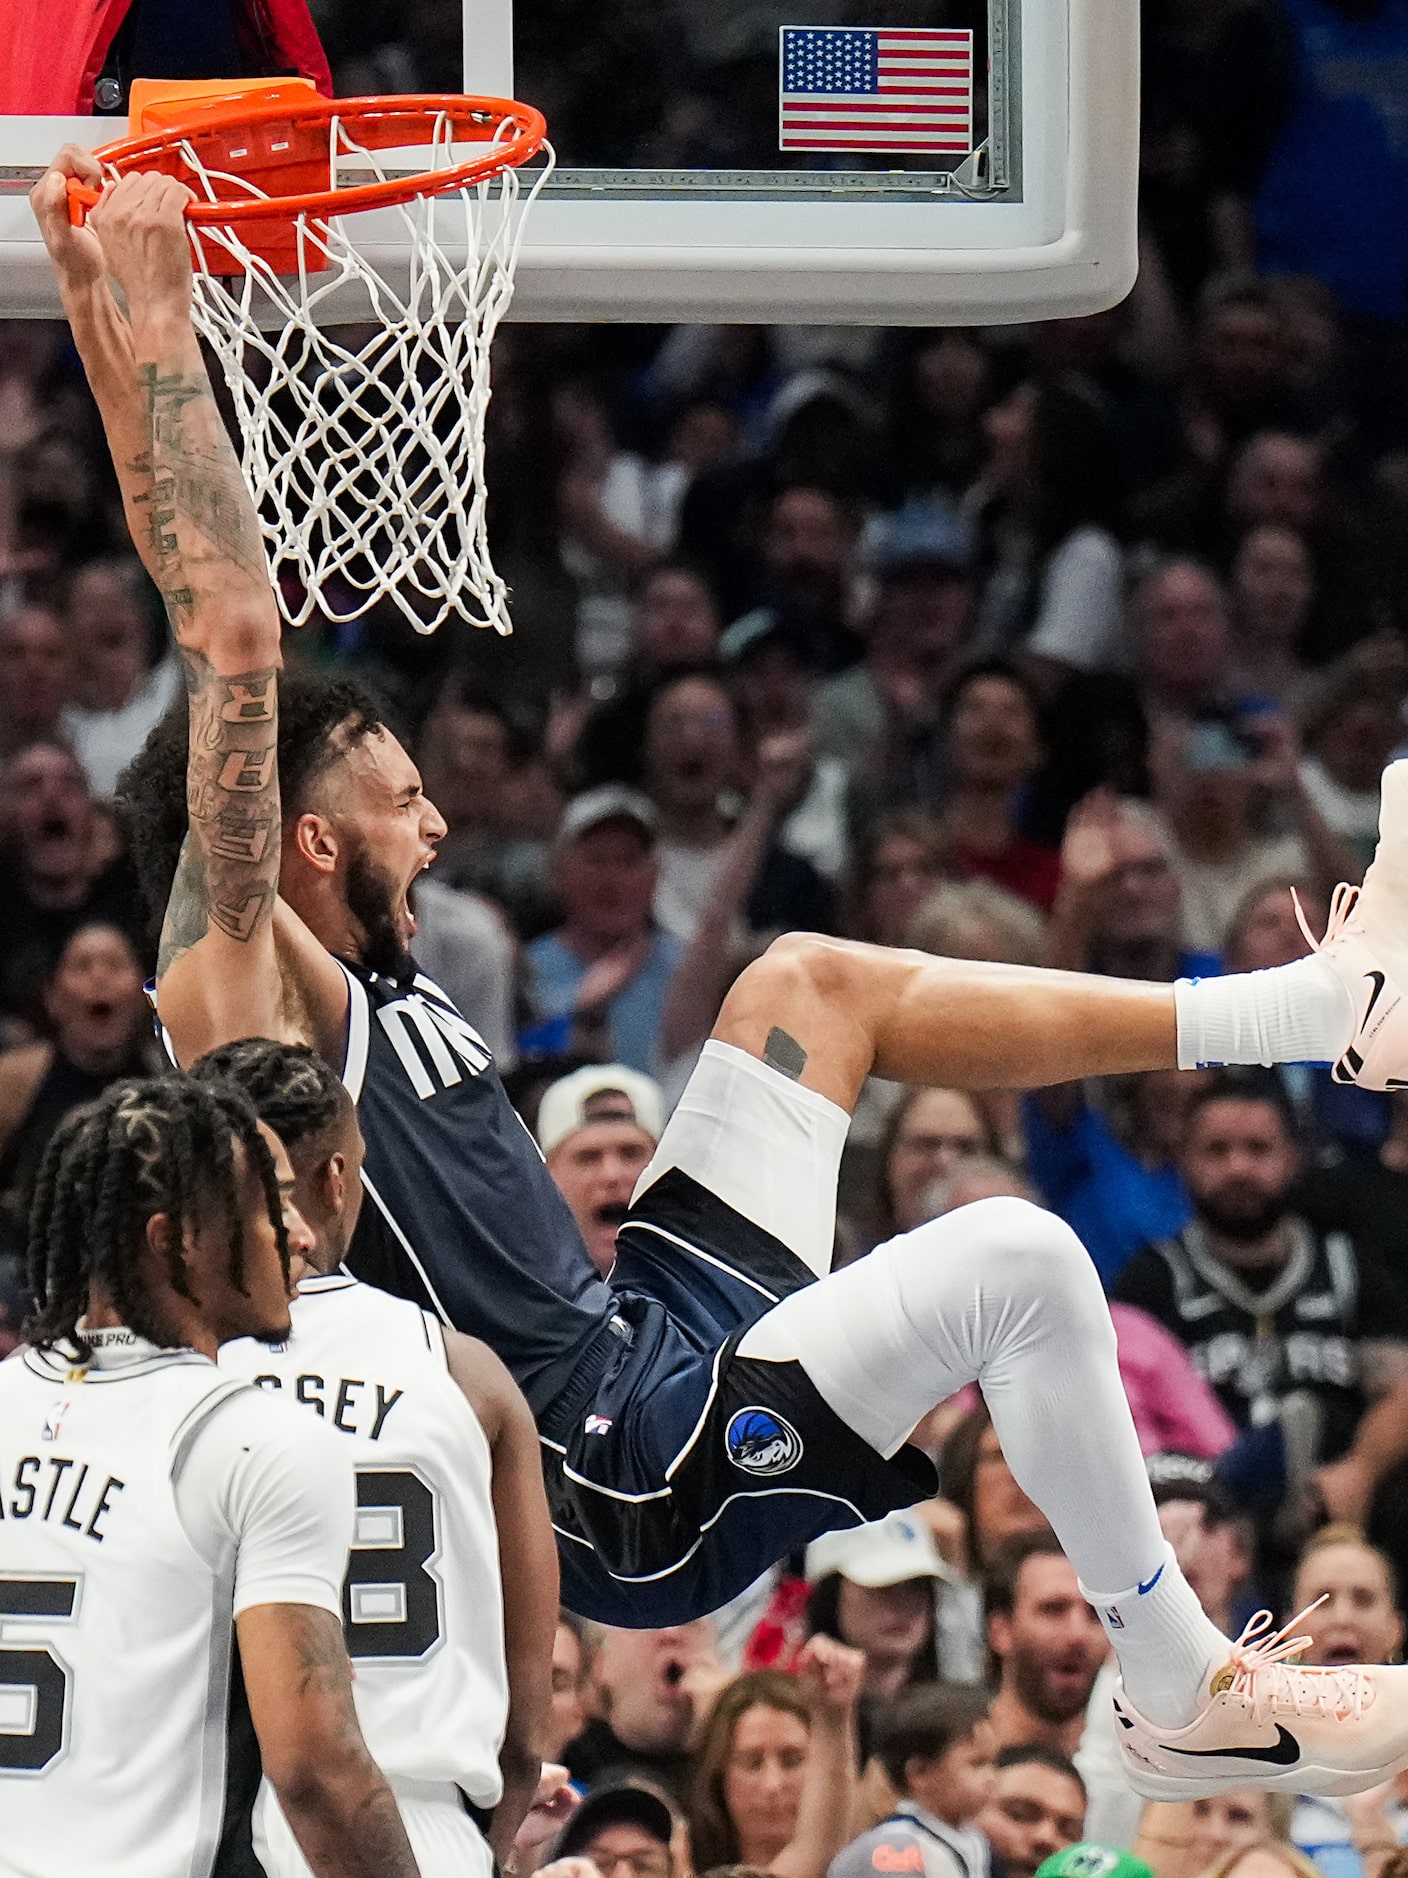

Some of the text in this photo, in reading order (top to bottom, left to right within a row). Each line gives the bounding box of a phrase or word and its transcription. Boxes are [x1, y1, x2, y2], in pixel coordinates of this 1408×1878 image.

[0, 1455, 126, 1543] STLE
[339, 1463, 447, 1667] 8
[0, 1571, 85, 1780] 5
